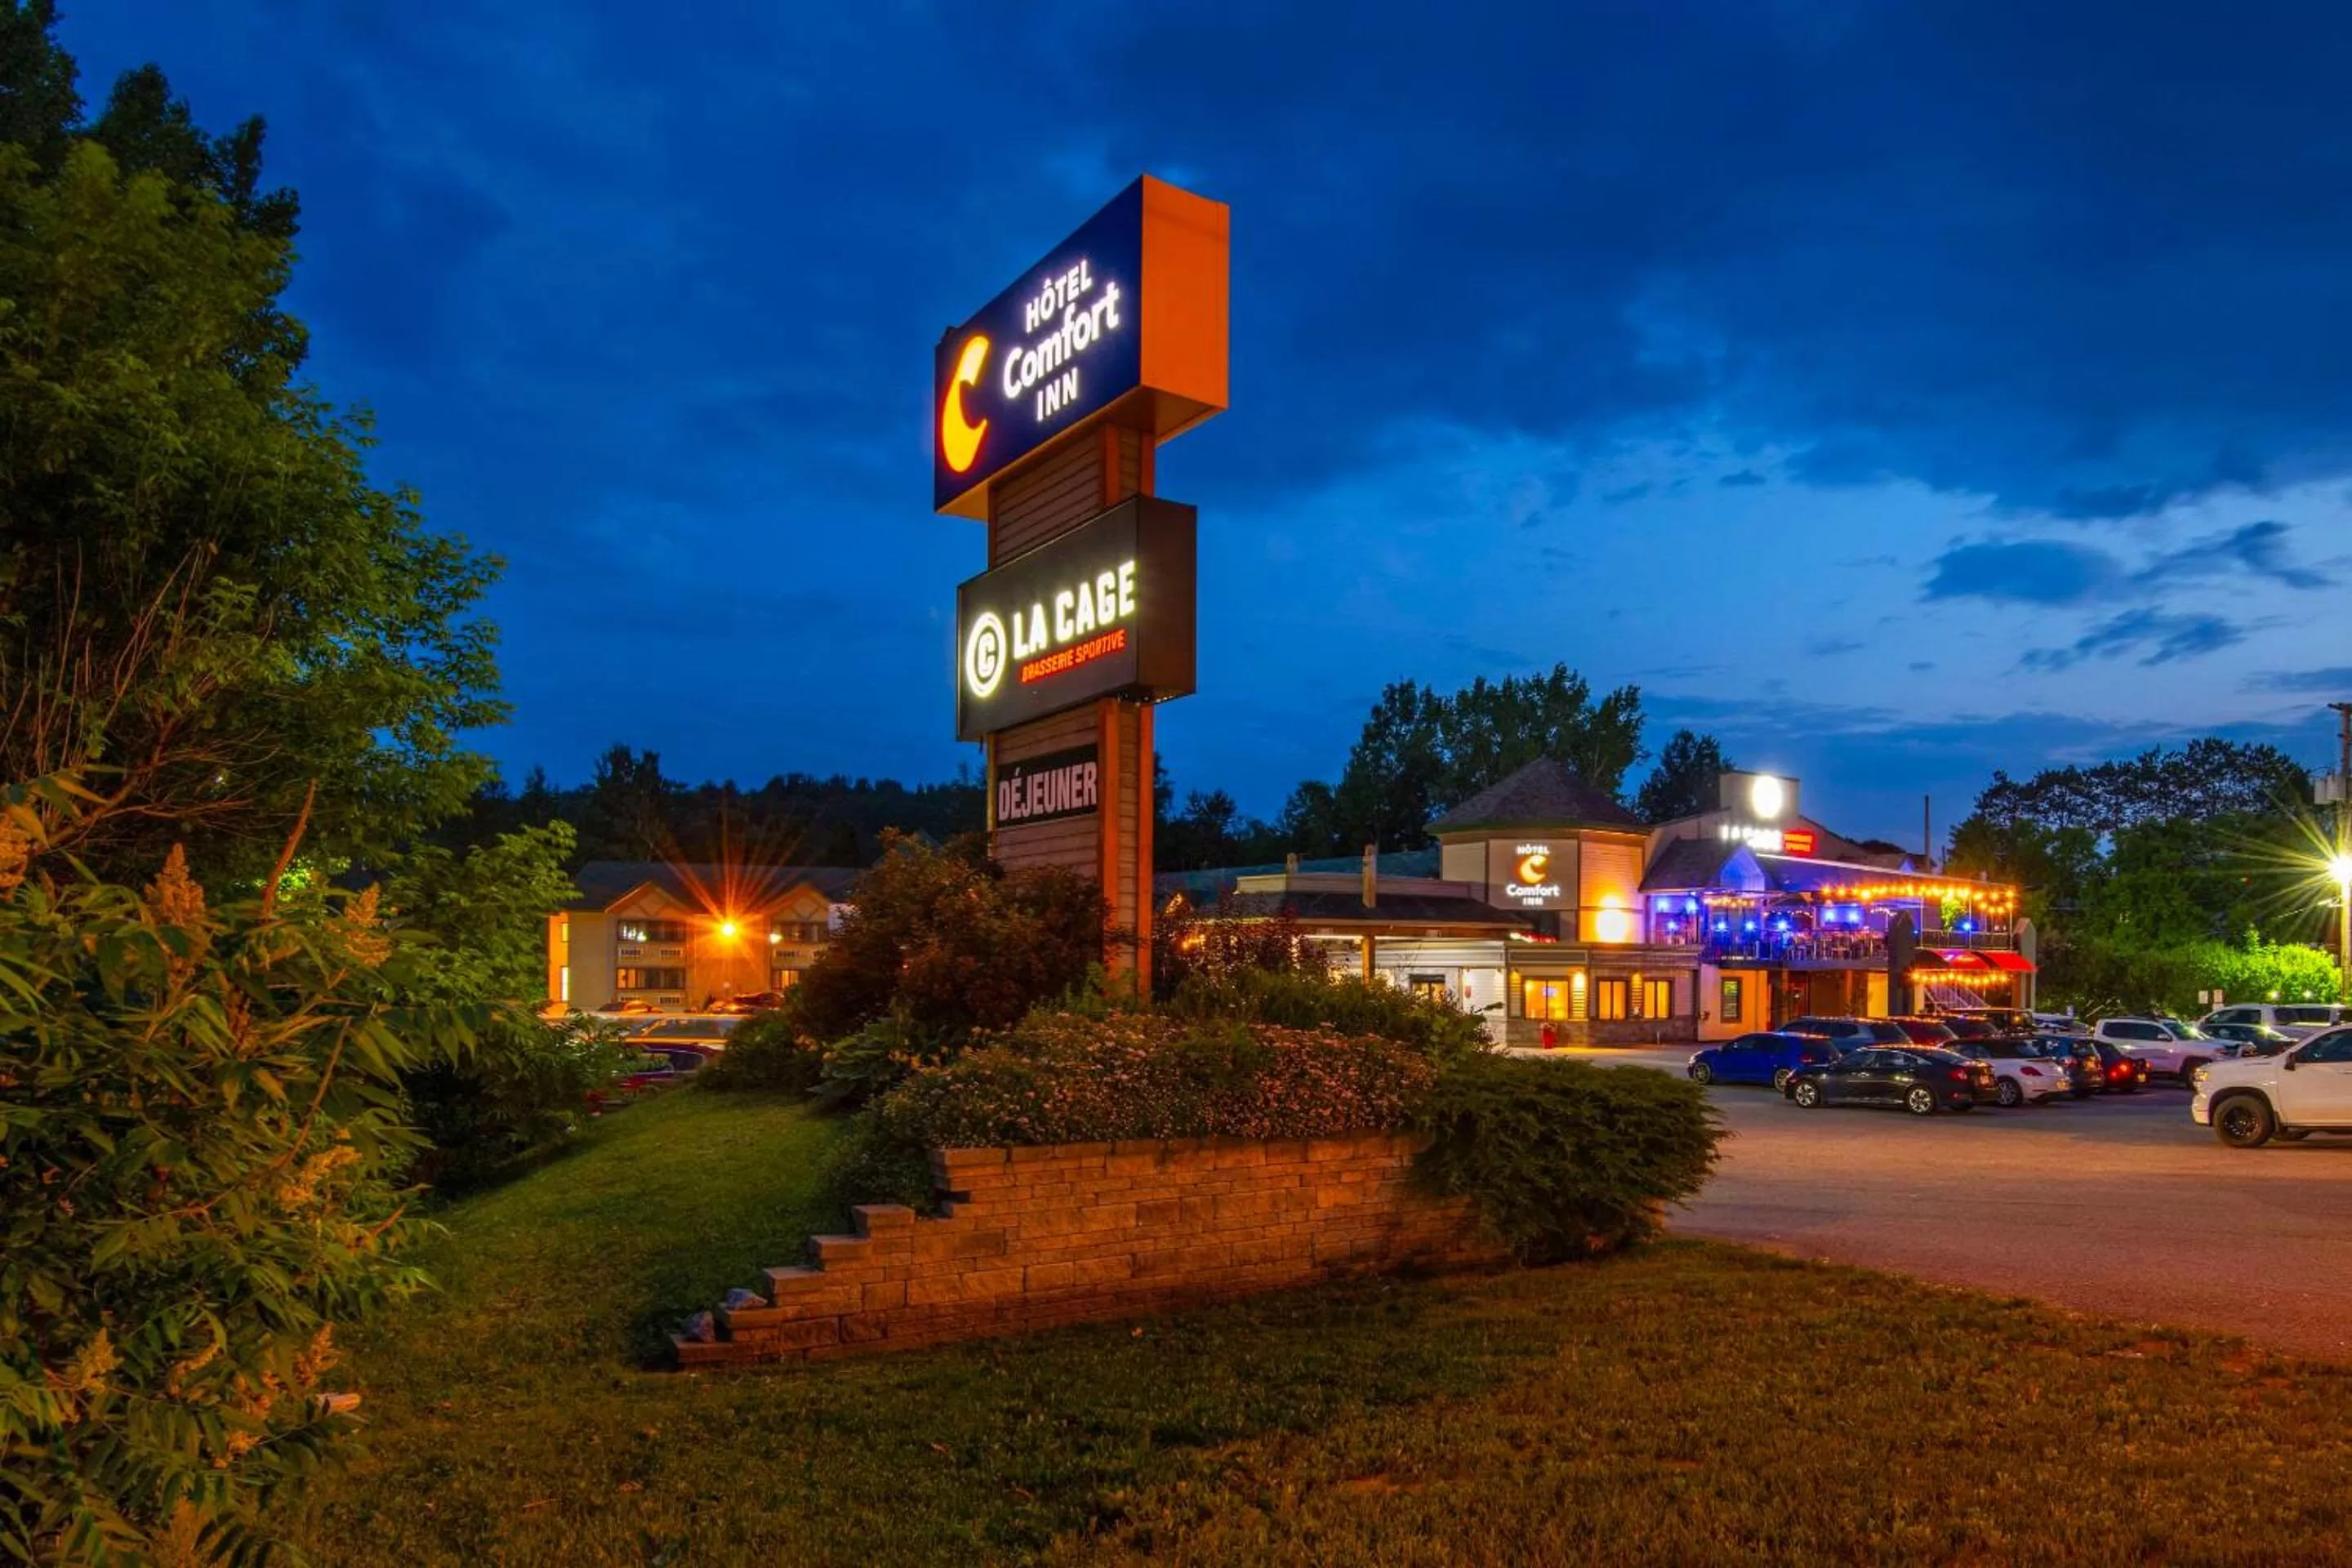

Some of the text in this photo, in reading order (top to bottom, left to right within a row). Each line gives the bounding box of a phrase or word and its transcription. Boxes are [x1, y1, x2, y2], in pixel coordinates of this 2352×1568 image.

[1026, 259, 1093, 333] HÔTEL
[1003, 282, 1120, 399] Comfort
[1036, 368, 1078, 421] INN
[1013, 560, 1136, 659] LA CAGE
[1021, 628, 1126, 684] BRASSERIE SPORTIVE
[998, 760, 1098, 821] DÉJEUNER
[1505, 883, 1561, 897] Comfort
